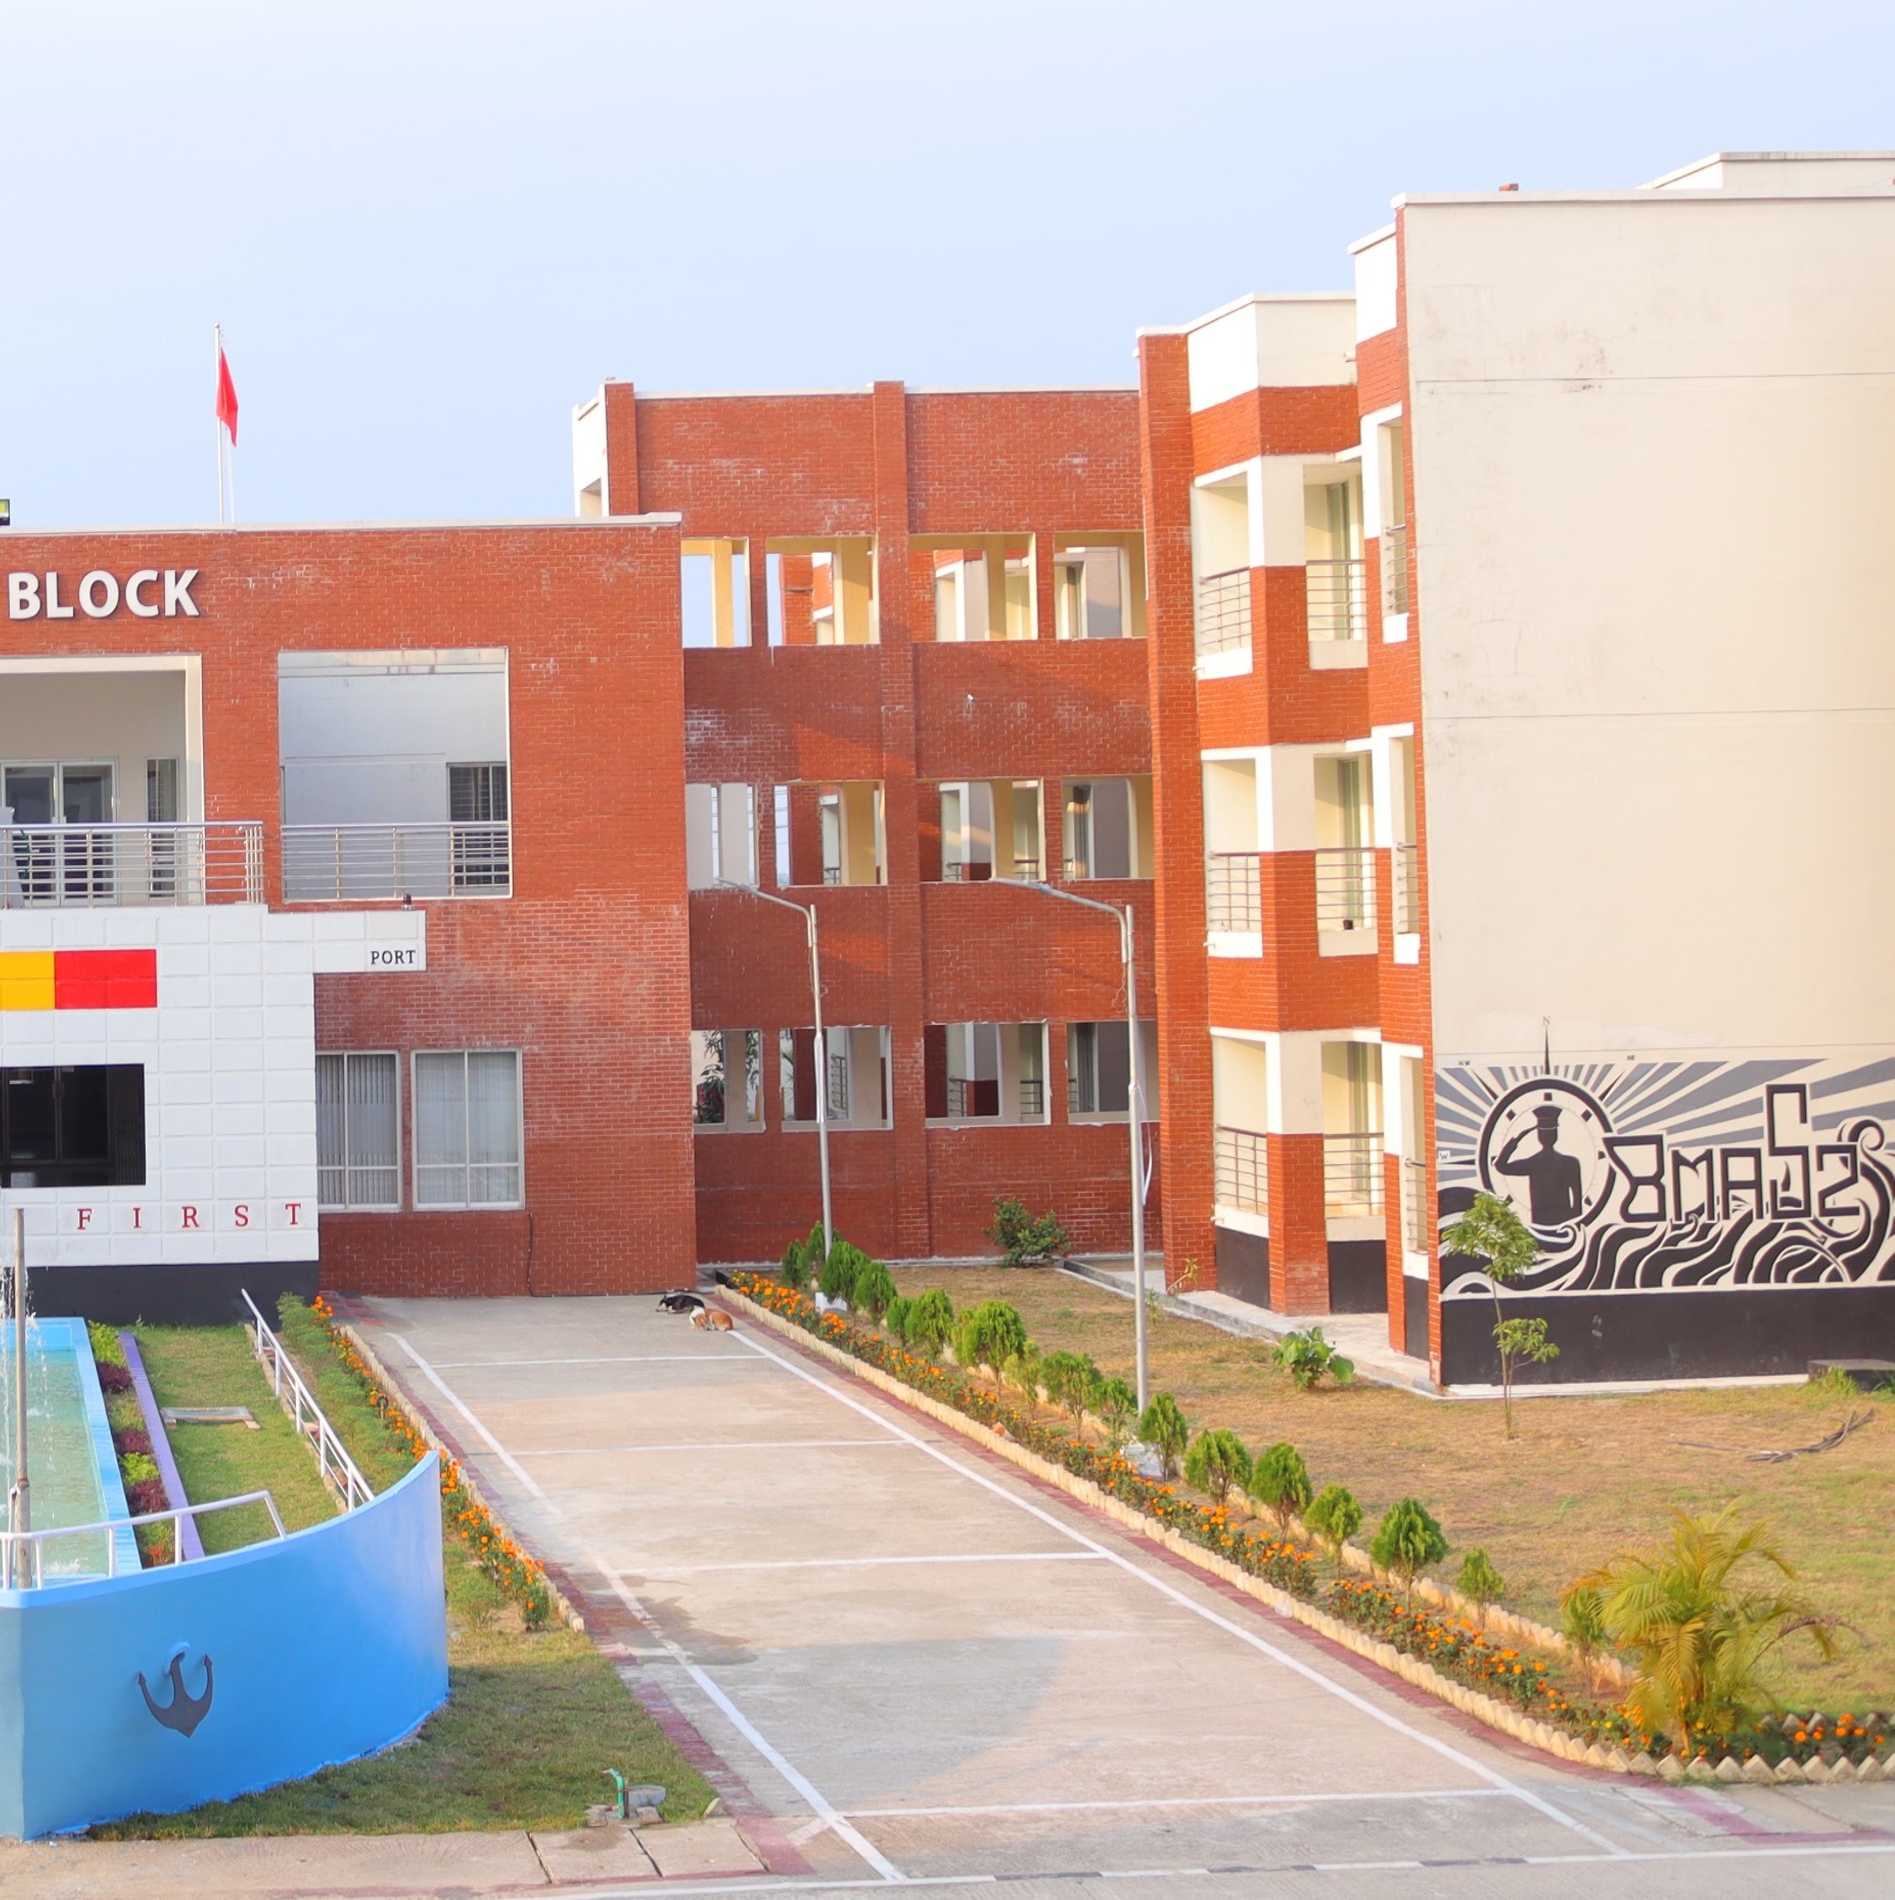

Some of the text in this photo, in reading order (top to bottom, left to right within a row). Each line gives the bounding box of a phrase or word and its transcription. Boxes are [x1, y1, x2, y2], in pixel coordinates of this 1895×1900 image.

[8, 569, 200, 620] BLOCK
[370, 950, 416, 965] PORT
[1542, 1016, 1551, 1025] N
[1440, 1152, 1449, 1161] W
[77, 1203, 302, 1230] FIRST
